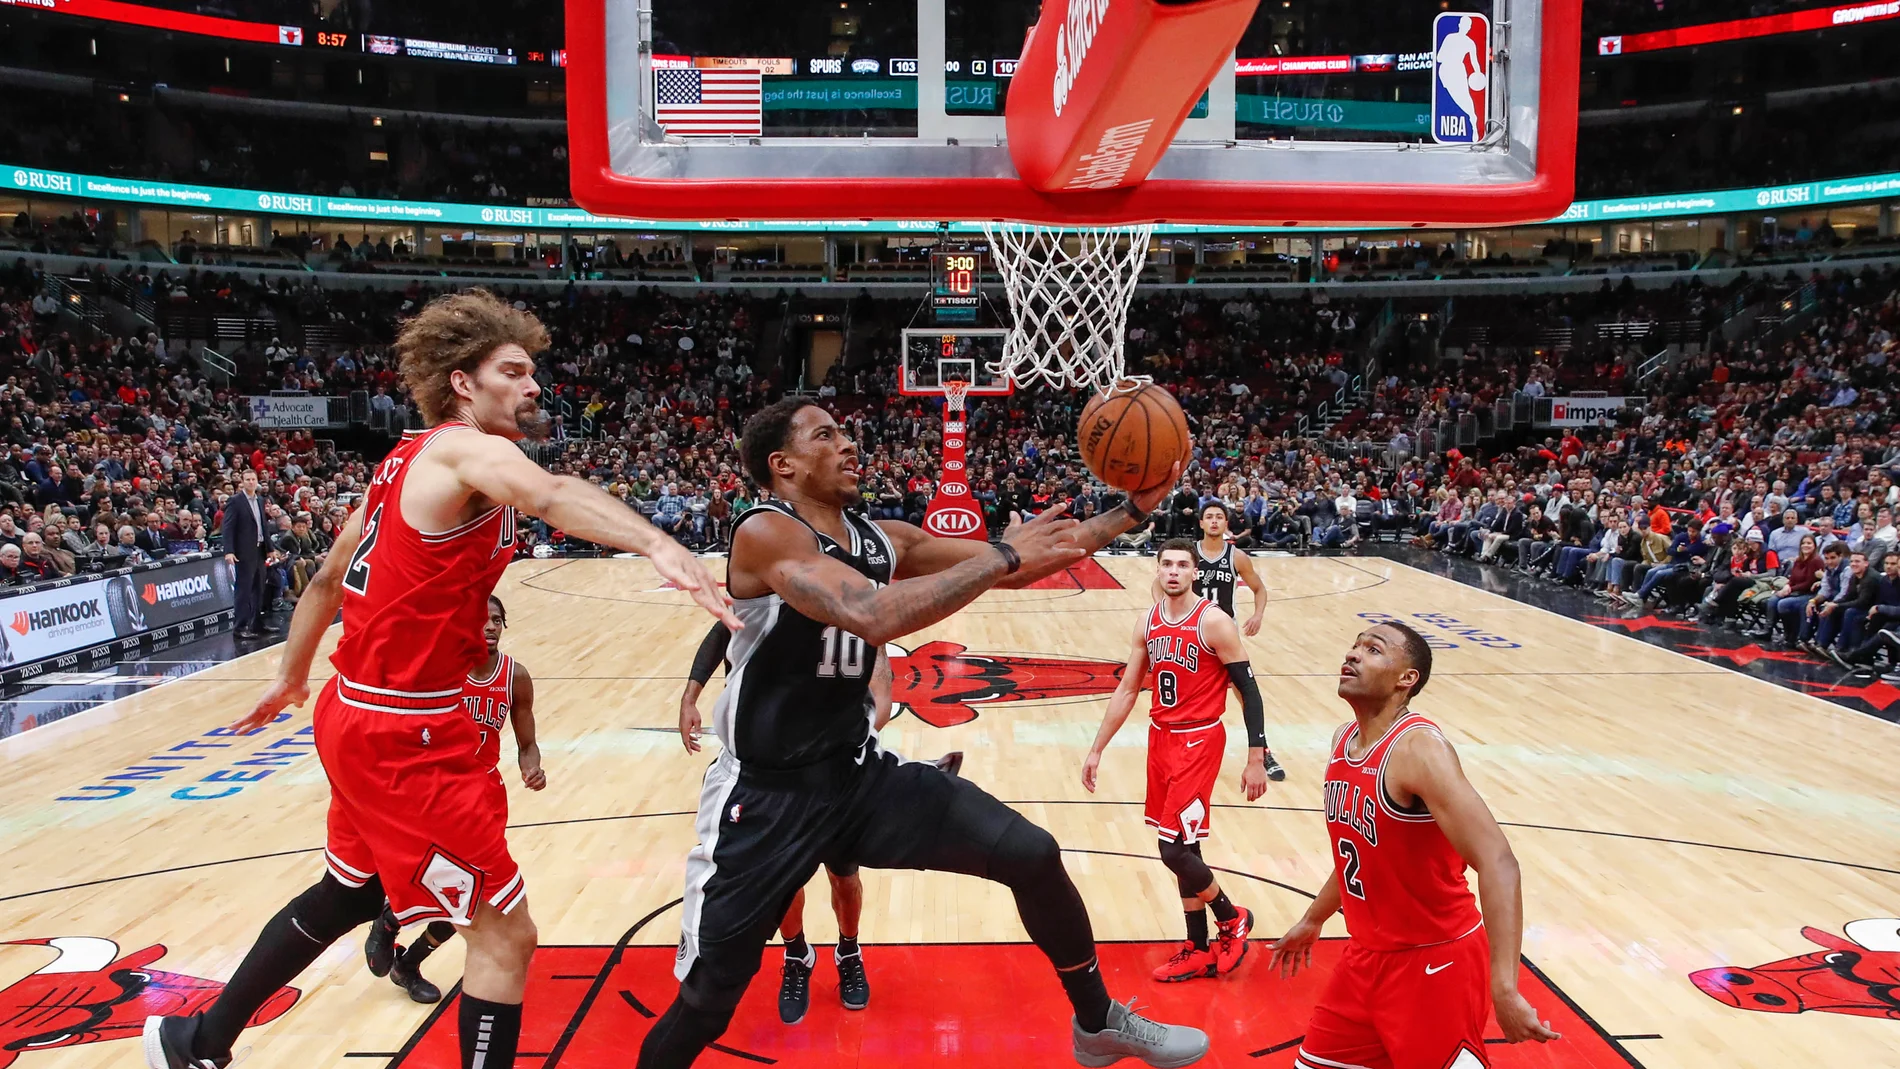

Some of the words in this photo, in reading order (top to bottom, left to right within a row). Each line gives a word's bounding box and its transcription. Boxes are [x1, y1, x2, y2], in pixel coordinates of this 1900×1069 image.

[318, 32, 347, 47] 8:57
[669, 59, 689, 69] CLUB
[757, 58, 781, 66] FOULS
[1398, 53, 1416, 62] SAN
[1416, 51, 1433, 61] ANT
[764, 66, 775, 74] 02
[810, 58, 842, 74] SPURS
[895, 61, 916, 72] 103
[975, 62, 982, 72] 4
[1281, 60, 1326, 72] CHAMPIONS
[1327, 59, 1347, 70] CLUB
[1397, 59, 1433, 71] CHICAG
[1440, 115, 1466, 137] NBA
[29, 171, 72, 192] RUSH
[87, 181, 130, 195] Excellence
[131, 184, 139, 195] is
[139, 186, 156, 198] just
[157, 187, 170, 198] the
[1770, 186, 1810, 205] RUSH
[272, 195, 313, 212] RUSH
[327, 201, 368, 213] Excellence
[368, 203, 376, 213] is
[376, 204, 391, 215] just
[392, 205, 404, 215] the
[1647, 201, 1663, 212] just
[1663, 199, 1677, 209] the
[494, 208, 533, 223] RUSH
[547, 212, 585, 222] Excellence
[946, 256, 975, 271] 3:00
[950, 270, 971, 293] 10
[946, 297, 978, 305] TISSOT
[272, 401, 314, 413] Advocate
[1566, 401, 1617, 424] impac
[273, 414, 303, 426] Health
[304, 414, 325, 425] Care
[945, 485, 963, 493] KIA
[936, 513, 972, 530] KIA
[171, 597, 191, 609] driving
[191, 591, 215, 603] emotion
[47, 625, 75, 639] driving
[75, 618, 106, 632] emotion
[1411, 612, 1522, 649] CENTER
[816, 624, 866, 679] 10
[1158, 670, 1177, 708] 8
[1338, 837, 1366, 901] 2
